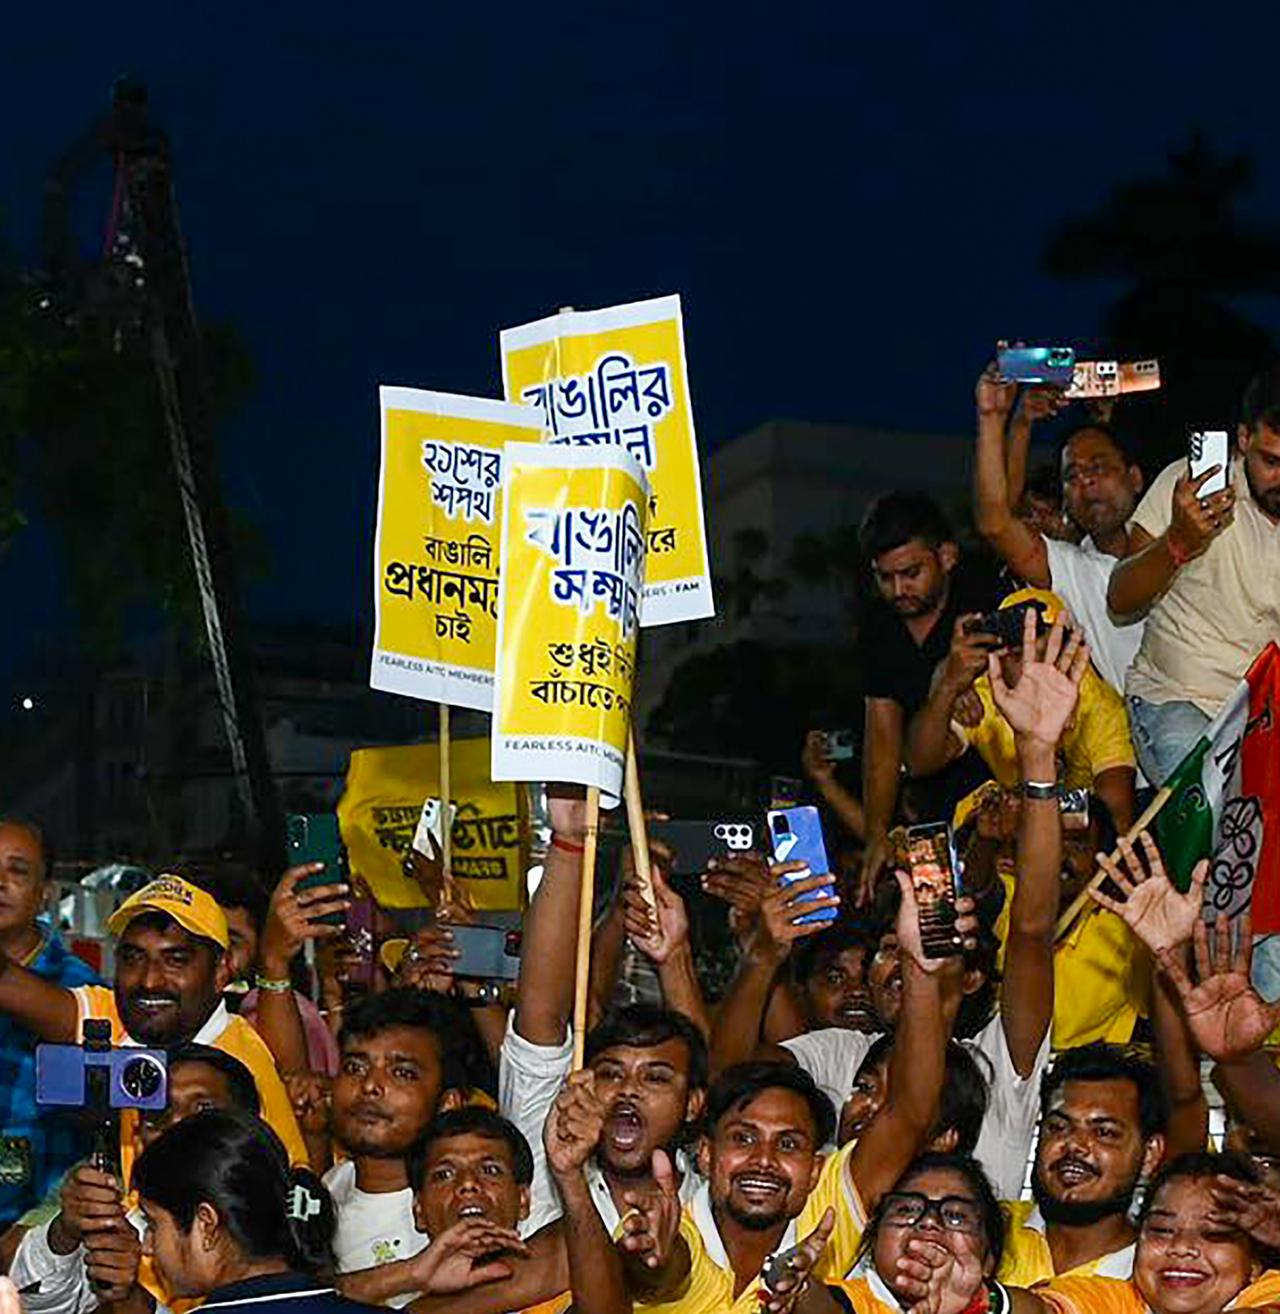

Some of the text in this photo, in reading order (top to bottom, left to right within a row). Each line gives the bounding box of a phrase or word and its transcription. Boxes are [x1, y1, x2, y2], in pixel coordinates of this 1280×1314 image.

[432, 482, 491, 521] শপথ
[423, 535, 493, 570] বাঙালি
[435, 611, 473, 643] চাই
[380, 655, 424, 672] FEARLESS
[504, 740, 572, 752] FEARLESS
